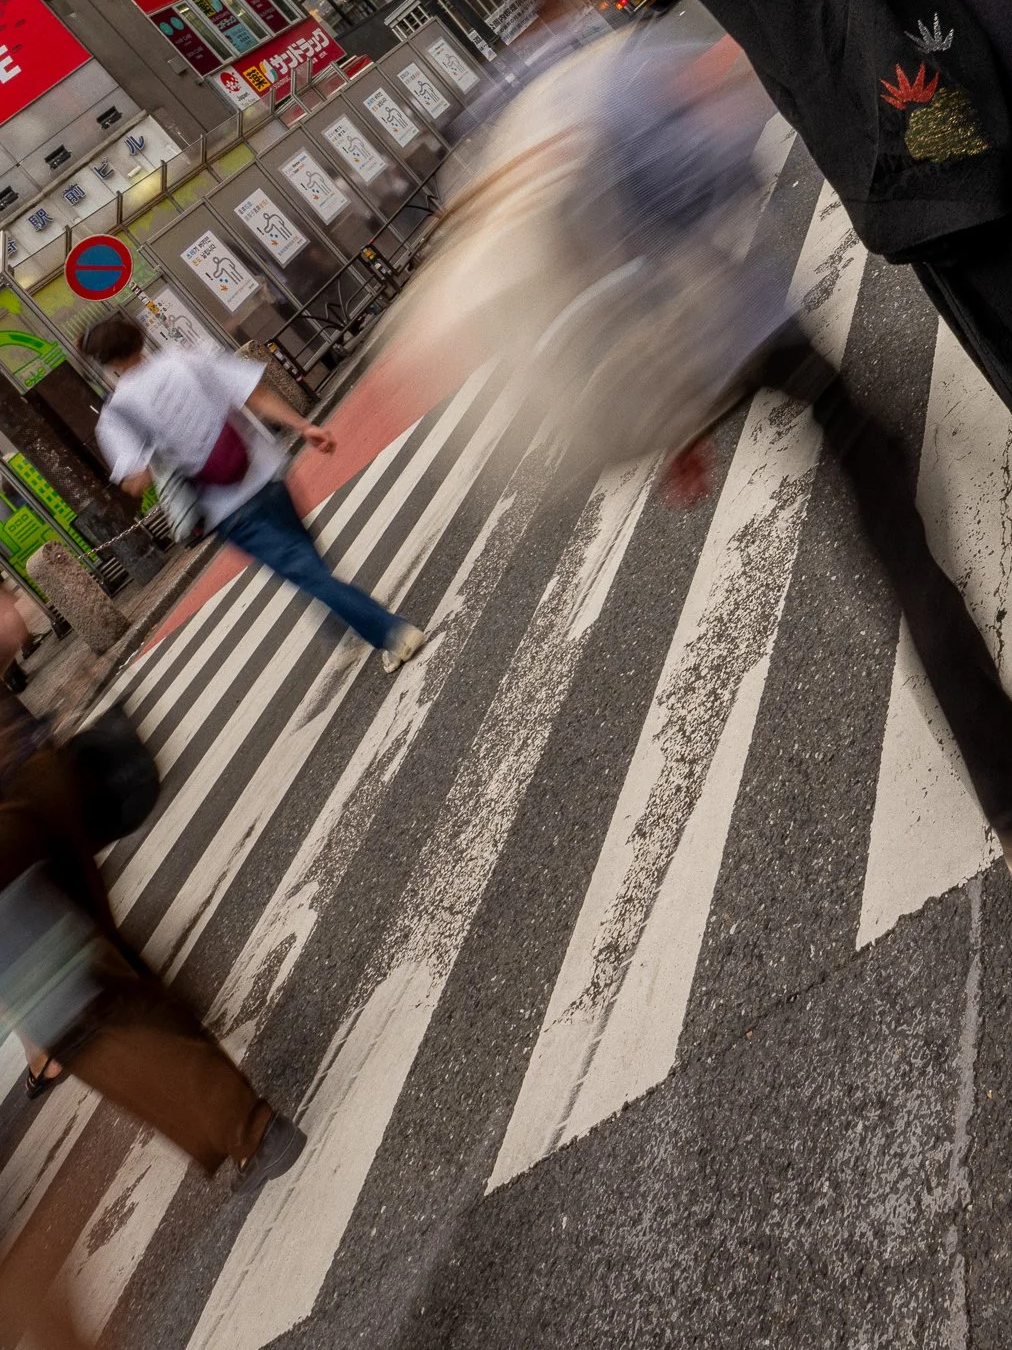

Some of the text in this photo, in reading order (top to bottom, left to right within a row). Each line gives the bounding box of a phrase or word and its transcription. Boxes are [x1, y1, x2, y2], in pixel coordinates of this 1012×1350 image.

[269, 27, 331, 75] サンドラッグ
[243, 67, 272, 92] 薬
